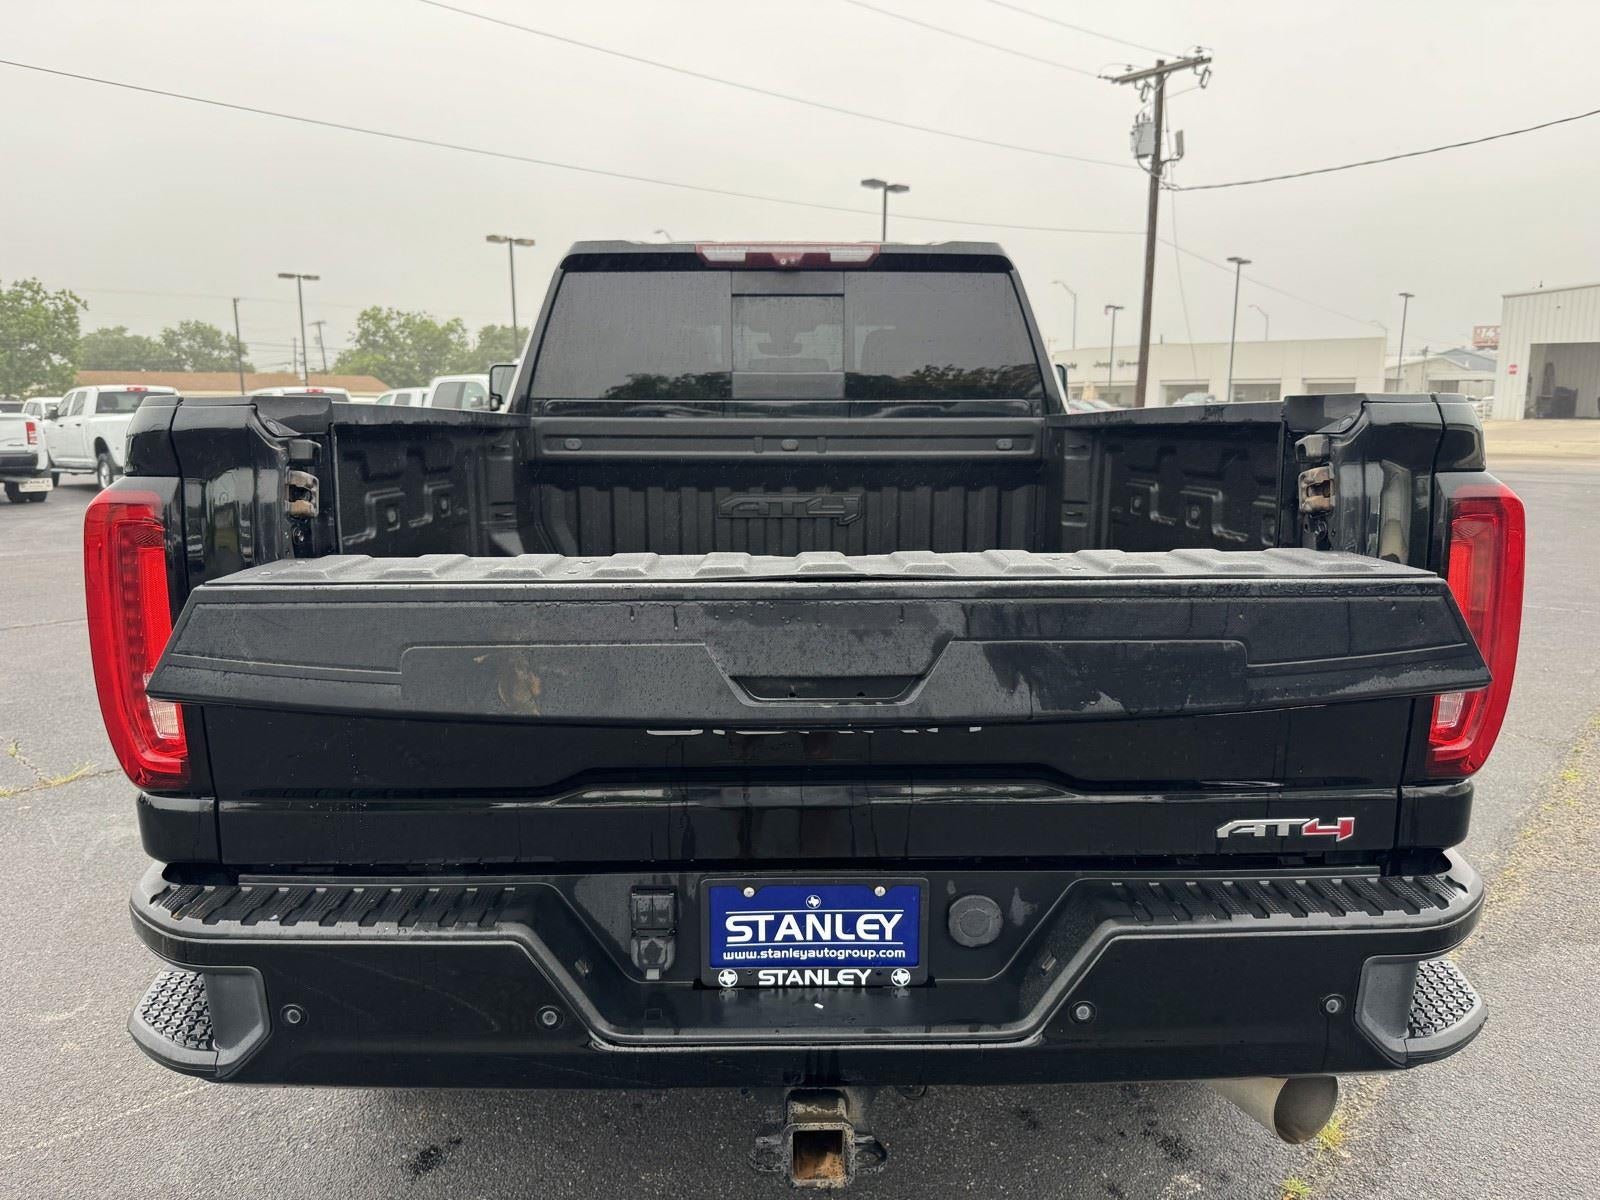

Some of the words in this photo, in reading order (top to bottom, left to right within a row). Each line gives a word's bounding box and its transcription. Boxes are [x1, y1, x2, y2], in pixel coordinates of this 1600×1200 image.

[719, 495, 861, 525] AT4
[1216, 817, 1355, 842] AT4
[725, 913, 904, 943] STANLEY
[722, 947, 906, 961] www.stanleyautogroup.com
[757, 968, 872, 986] STANLEY
